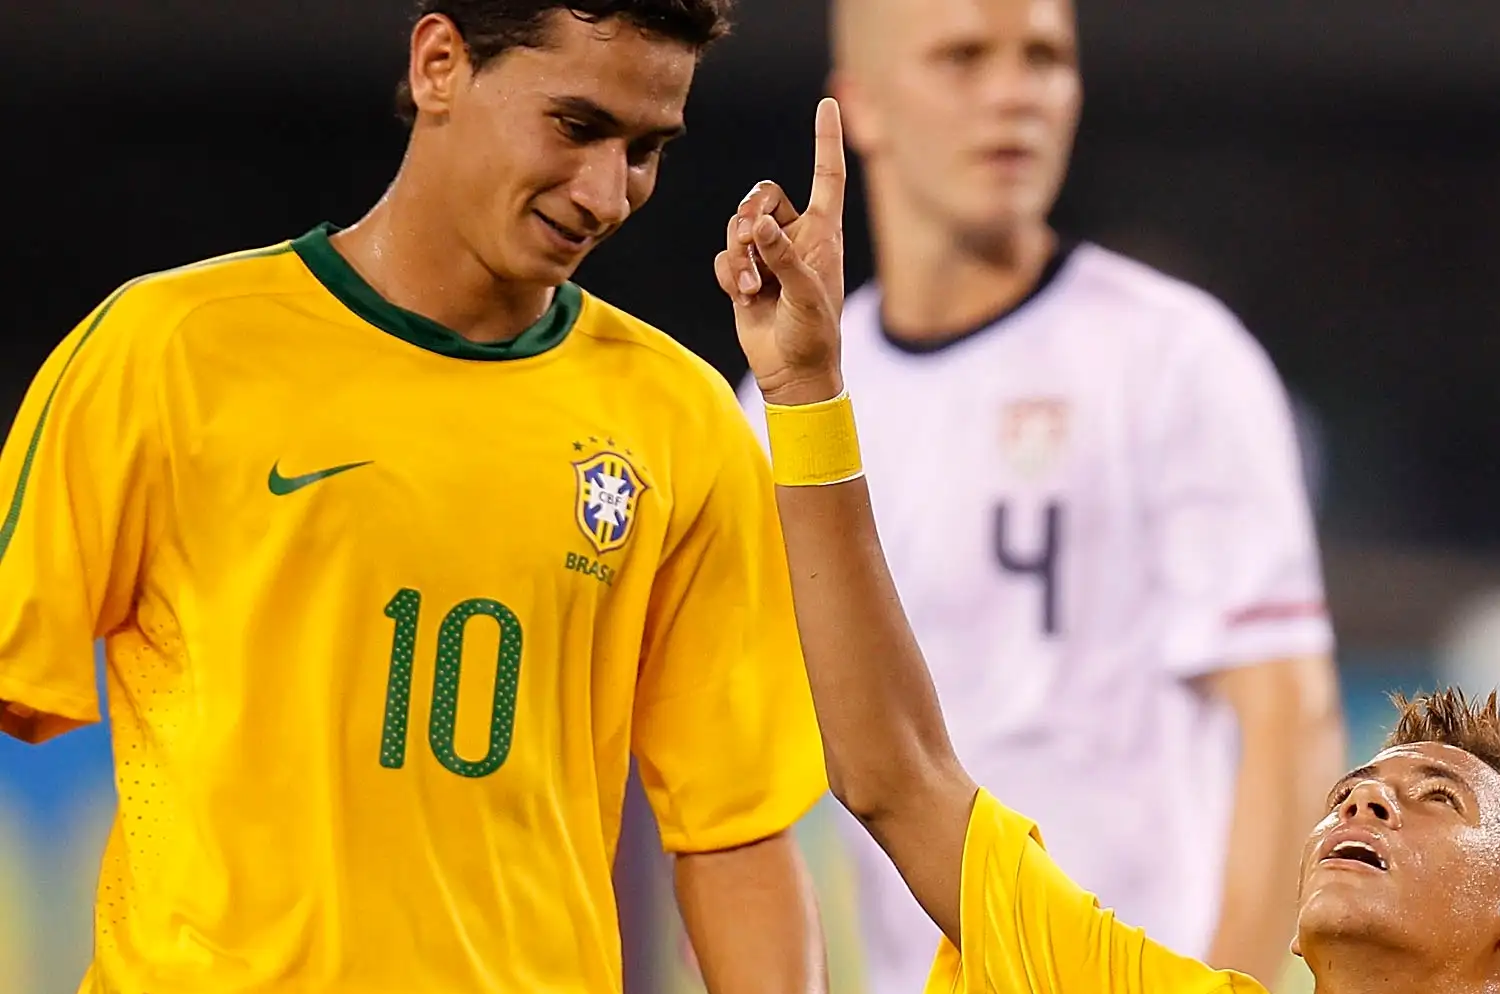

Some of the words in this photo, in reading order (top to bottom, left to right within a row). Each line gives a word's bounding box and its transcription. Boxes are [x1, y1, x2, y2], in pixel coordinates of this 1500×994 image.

[598, 490, 623, 506] CBF
[989, 498, 1064, 636] 4
[379, 587, 523, 778] 10
